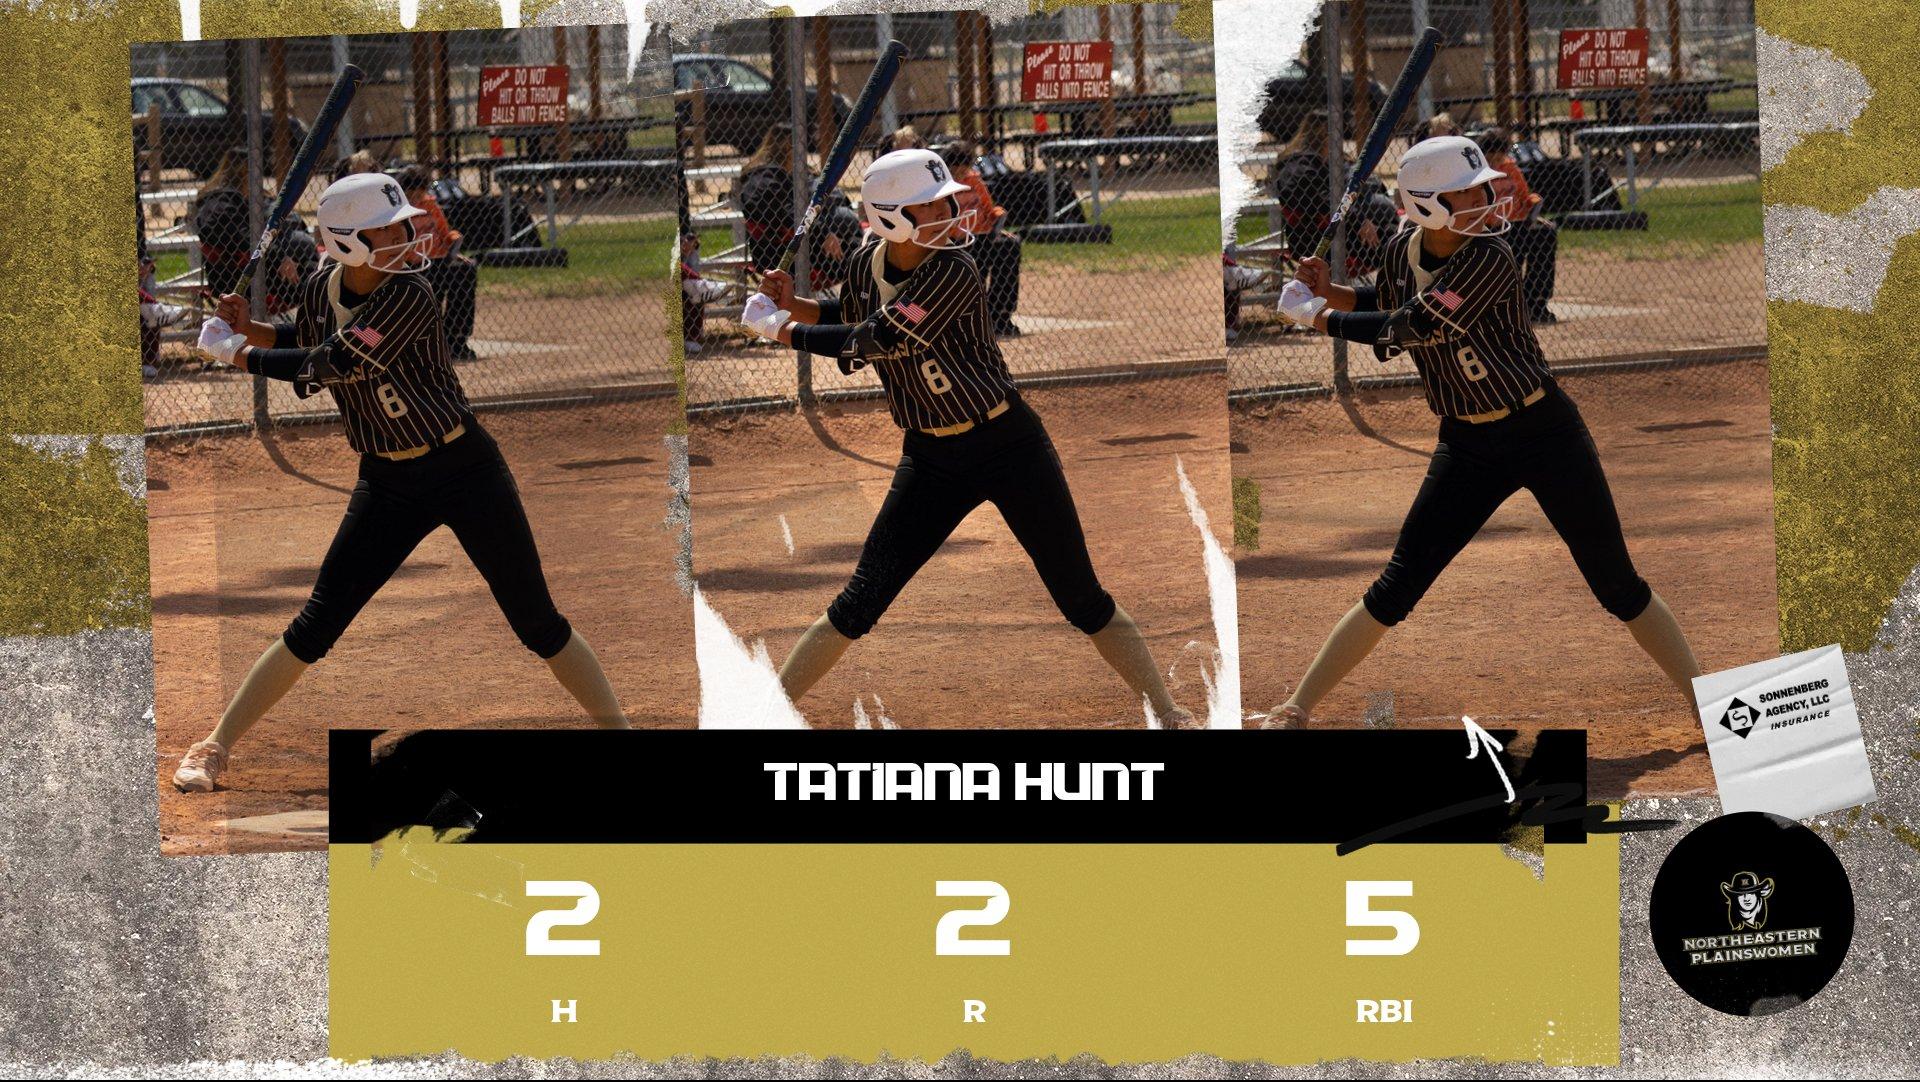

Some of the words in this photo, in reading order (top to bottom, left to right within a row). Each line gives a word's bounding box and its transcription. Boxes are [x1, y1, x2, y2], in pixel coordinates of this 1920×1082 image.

[1563, 32, 1590, 60] Please
[1595, 31, 1607, 49] DO
[1610, 31, 1627, 48] NOT
[1027, 45, 1054, 73] Please
[1059, 44, 1071, 62] DO
[1074, 44, 1091, 61] NOT
[1579, 50, 1593, 68] HIT
[1595, 50, 1607, 67] OR
[1610, 49, 1640, 66] THROW
[515, 68, 527, 86] DO
[530, 68, 547, 84] NOT
[1043, 63, 1057, 80] HIT
[1059, 63, 1071, 80] OR
[1074, 62, 1104, 80] THROW
[1571, 69, 1595, 87] BALLS
[1597, 69, 1616, 86] INTO
[1619, 68, 1646, 85] FENCE
[483, 69, 510, 97] Please
[1035, 82, 1059, 99] BALLS
[1061, 81, 1080, 99] INTO
[1082, 81, 1110, 98] FENCE
[499, 88, 513, 104] HIT
[515, 87, 527, 104] OR
[530, 86, 560, 103] THROW
[491, 106, 515, 124] BALLS
[517, 105, 536, 122] INTO
[539, 105, 566, 121] FENCE
[1457, 345, 1488, 382] 8
[921, 359, 952, 395] 8
[377, 382, 408, 419] 8
